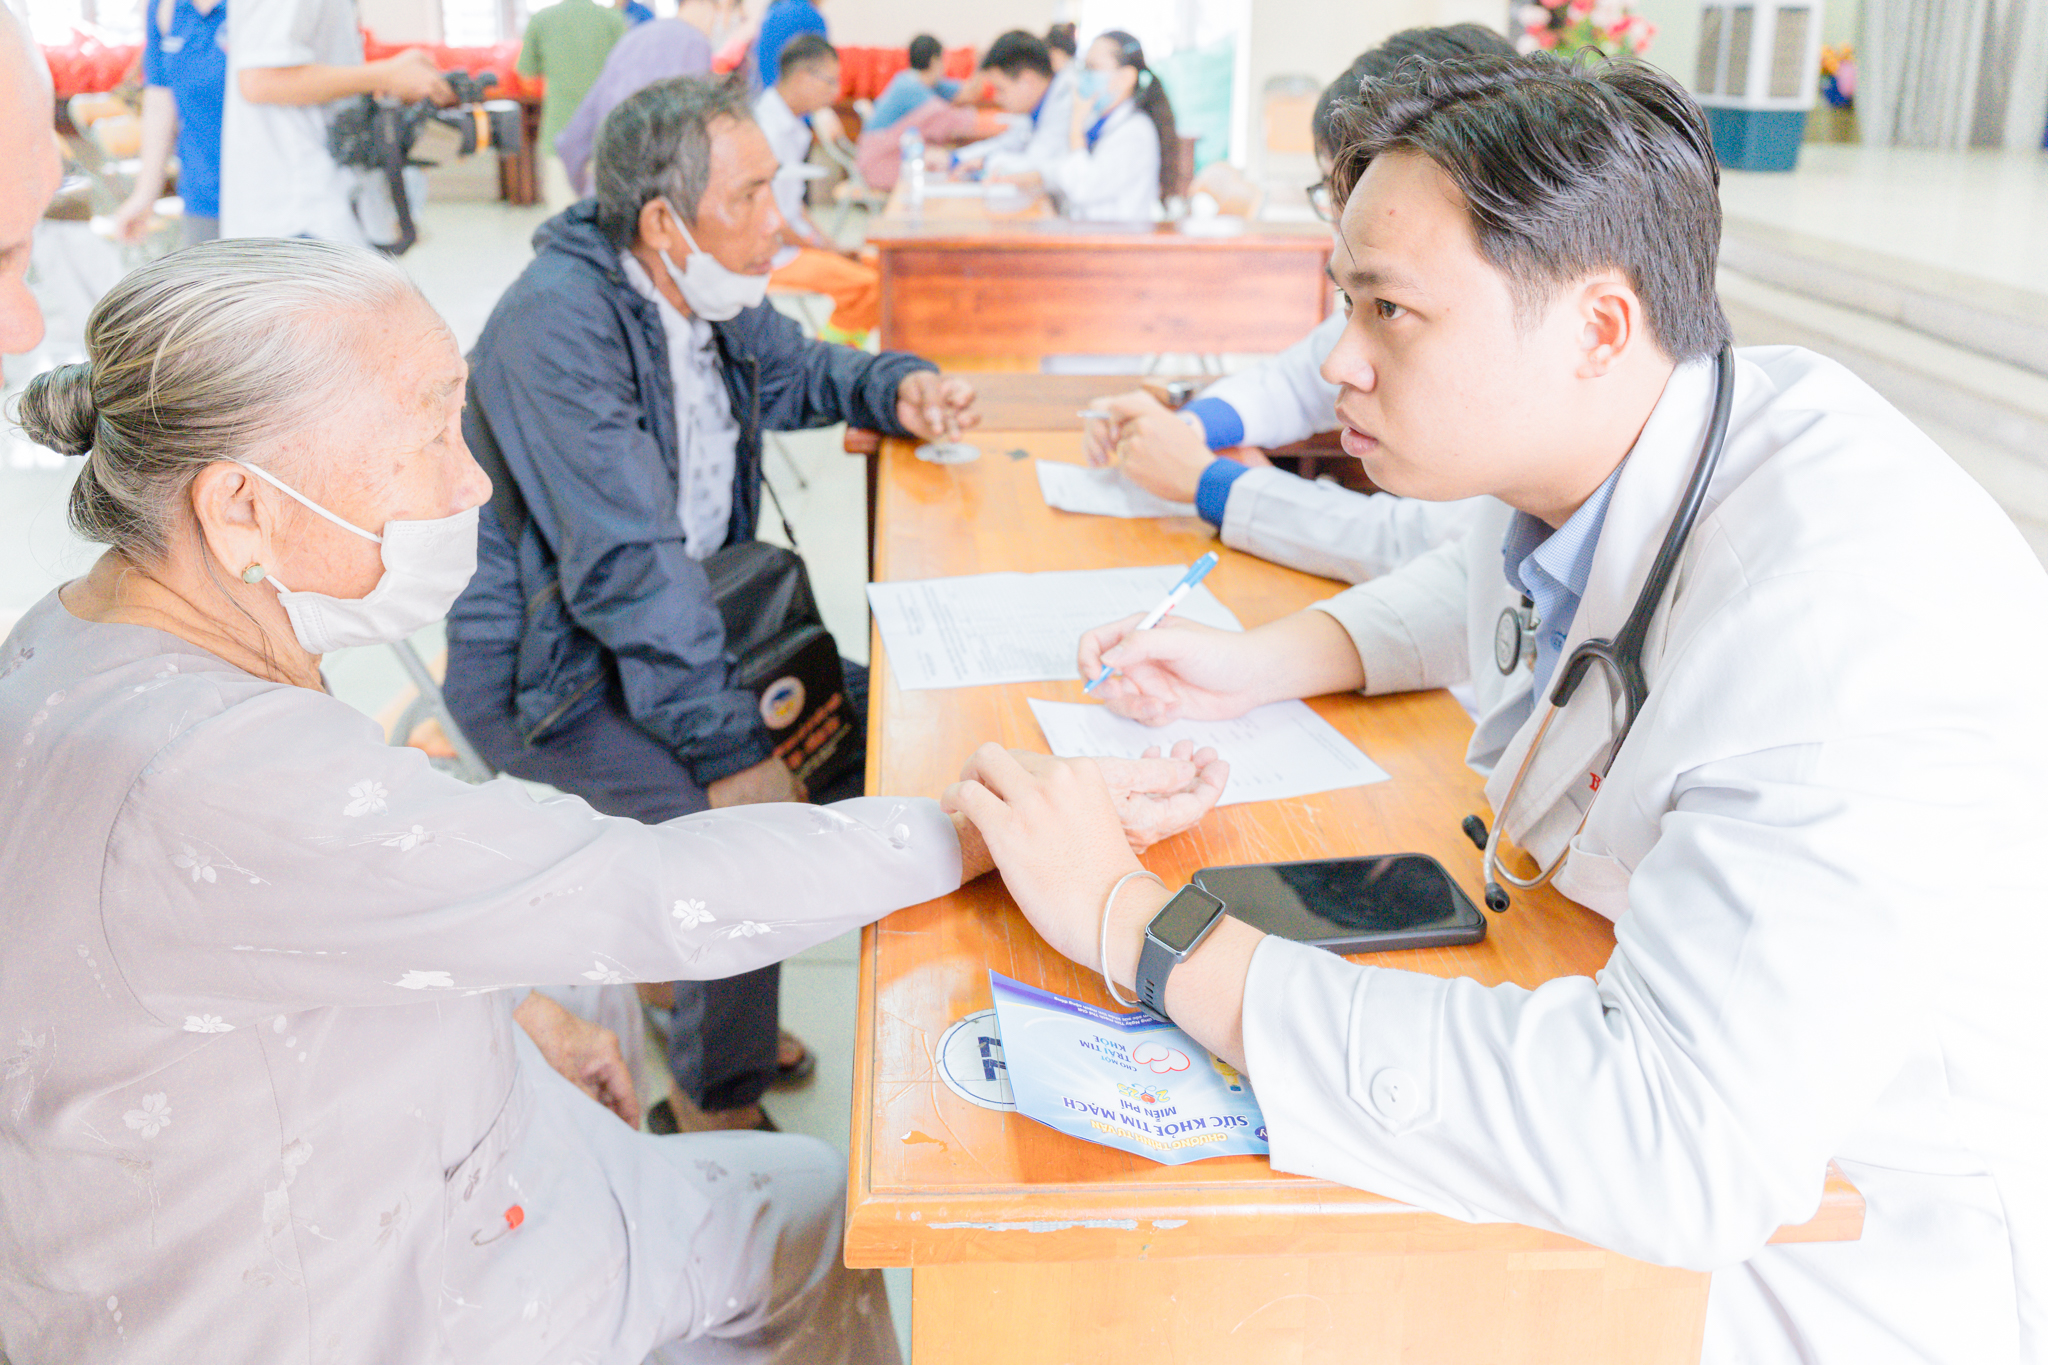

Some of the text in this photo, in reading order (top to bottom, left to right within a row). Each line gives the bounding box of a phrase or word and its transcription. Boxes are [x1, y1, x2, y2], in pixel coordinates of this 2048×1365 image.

[1079, 1039, 1131, 1063] TRÁI TIM
[1093, 1034, 1126, 1052] KHỎE
[1119, 1062, 1138, 1072] CHO
[1063, 1097, 1248, 1138] SỨC KHỎE TIM MẠCH
[1120, 1099, 1177, 1122] MIỄN PHÍ
[1090, 1119, 1228, 1151] CHƯƠNG TRÌNH TƯ VẤN
